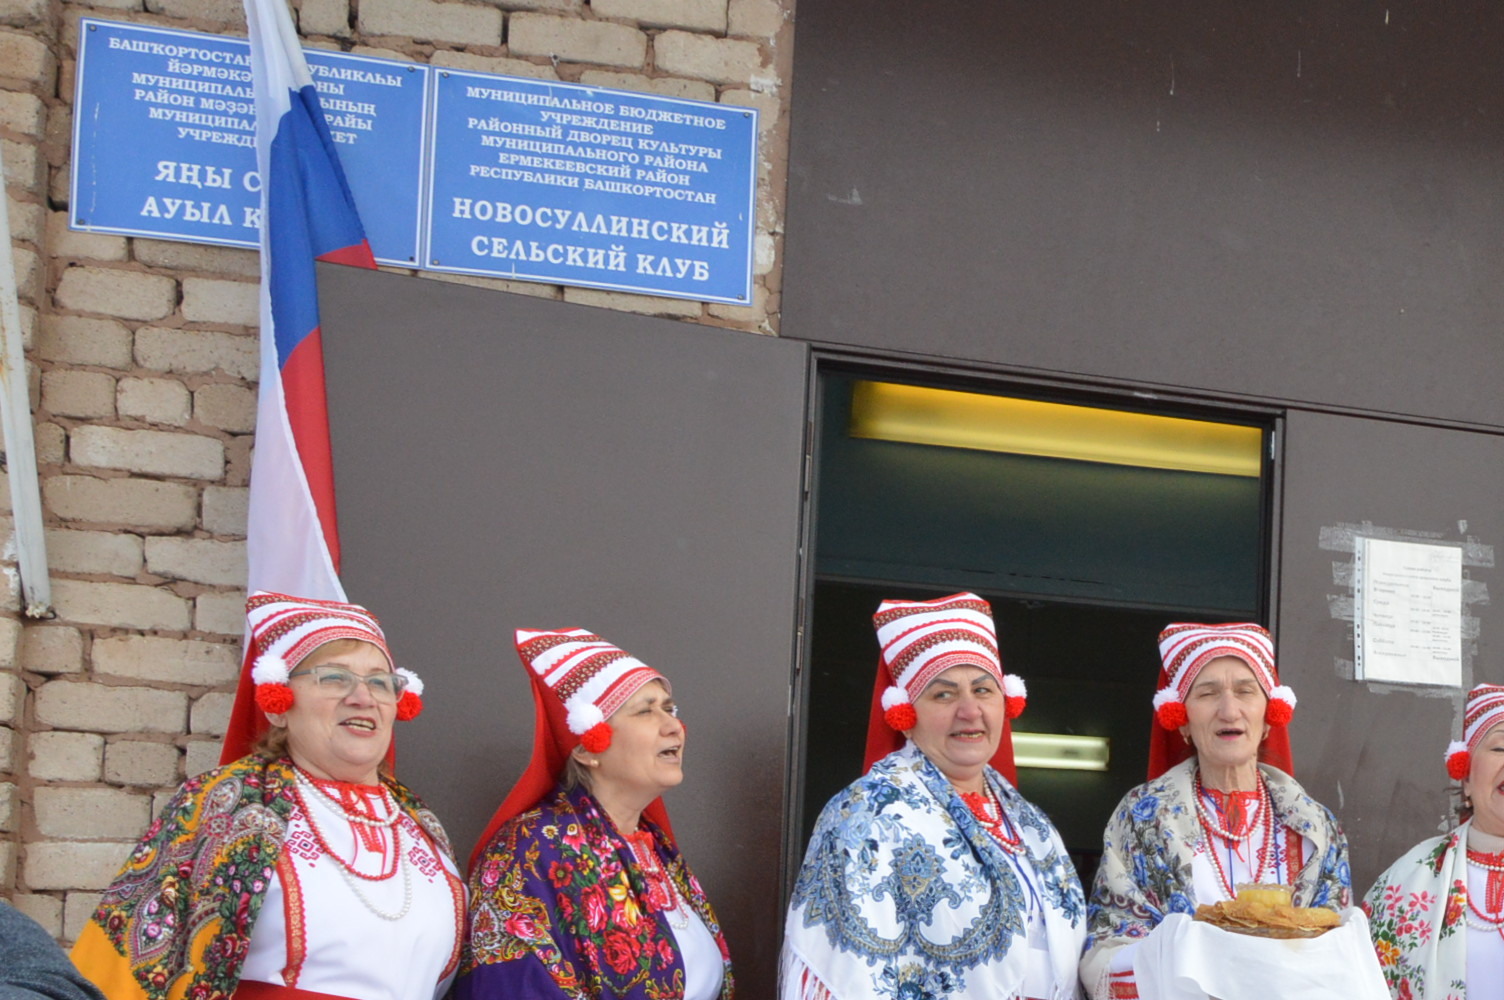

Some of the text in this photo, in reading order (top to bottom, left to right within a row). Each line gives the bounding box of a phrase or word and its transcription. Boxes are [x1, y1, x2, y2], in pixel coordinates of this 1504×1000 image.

[167, 58, 254, 82] ЙӘРМӘКӘ
[308, 64, 402, 87] УБЛИКАҺЫ
[134, 89, 195, 107] РАЙОН
[200, 98, 256, 115] МӘҘӘН
[466, 86, 726, 130] МУНИЦИПАЛЬНОЕ БЮДЖЕТНОЕ
[149, 107, 256, 131] МУНИЦИПАЛ
[541, 111, 653, 135] УЧРЕЖДЕНИЕ
[468, 118, 722, 159] РАЙОННЫЙ ДВОРЕЦ КУЛЬТУРЫ
[481, 135, 708, 173] МУНИЦИПАЛЬНОГО РАЙОНА
[154, 161, 232, 189] ЯҢЫ
[499, 152, 690, 185] ЕРМЕКЕЕВСКИЙ РАЙОН
[470, 165, 716, 204] РЕСПУБЛИКИ БАШКОРТОСТАН
[140, 196, 232, 225] АУЫЛ
[452, 198, 730, 249] НОВОСУЛЛИНСКИЙ
[471, 236, 709, 281] СЕЛЬСКИЙ КЛУБ
